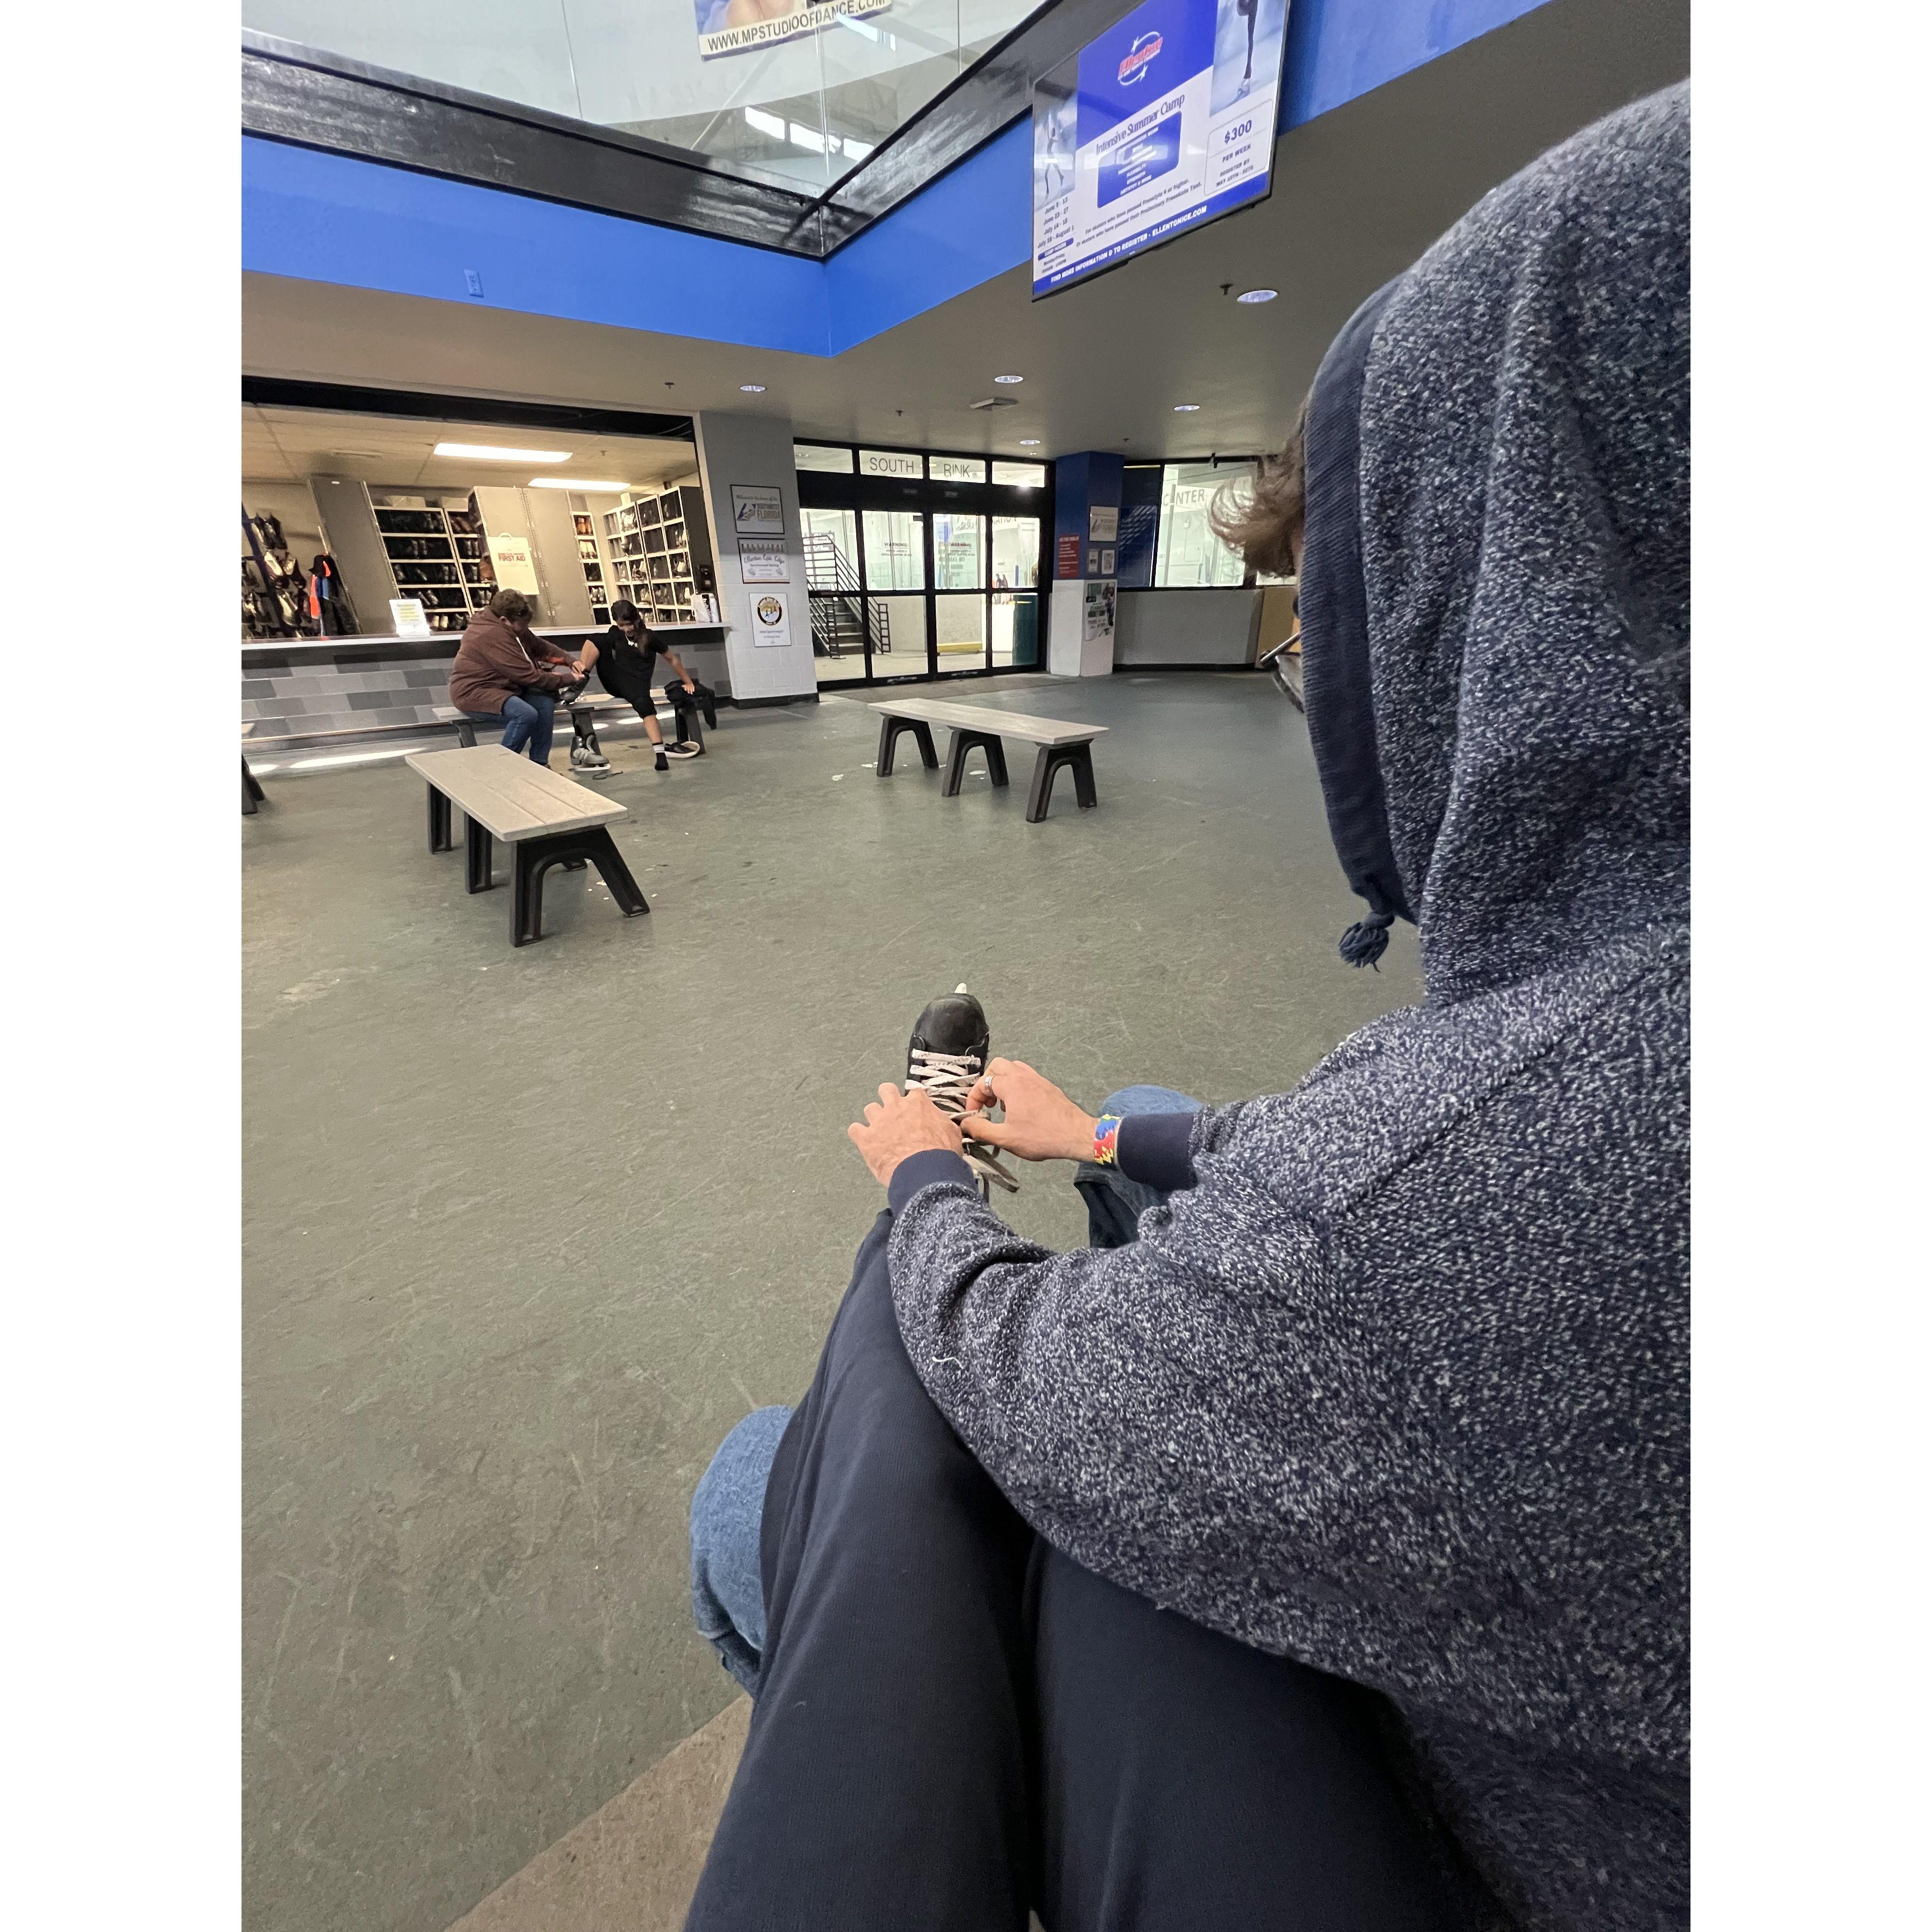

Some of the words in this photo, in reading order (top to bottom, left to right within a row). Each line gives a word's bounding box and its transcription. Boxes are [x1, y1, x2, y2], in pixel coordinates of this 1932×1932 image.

[1096, 131, 1127, 155] Intensive
[1127, 109, 1160, 136] Summer
[1161, 94, 1185, 115] Camp
[1224, 120, 1252, 145] $300
[1222, 152, 1233, 163] PER
[1235, 143, 1252, 157] WEEK
[1075, 252, 1108, 272] INFORMATION
[1114, 245, 1120, 254] TO
[1122, 233, 1148, 250] REGISTER
[1152, 205, 1207, 236] ELLENTONICE.COM
[870, 457, 914, 473] SOUTH
[943, 463, 970, 478] RINK
[1163, 489, 1205, 506] CNTER
[757, 510, 780, 519] FLORIDA
